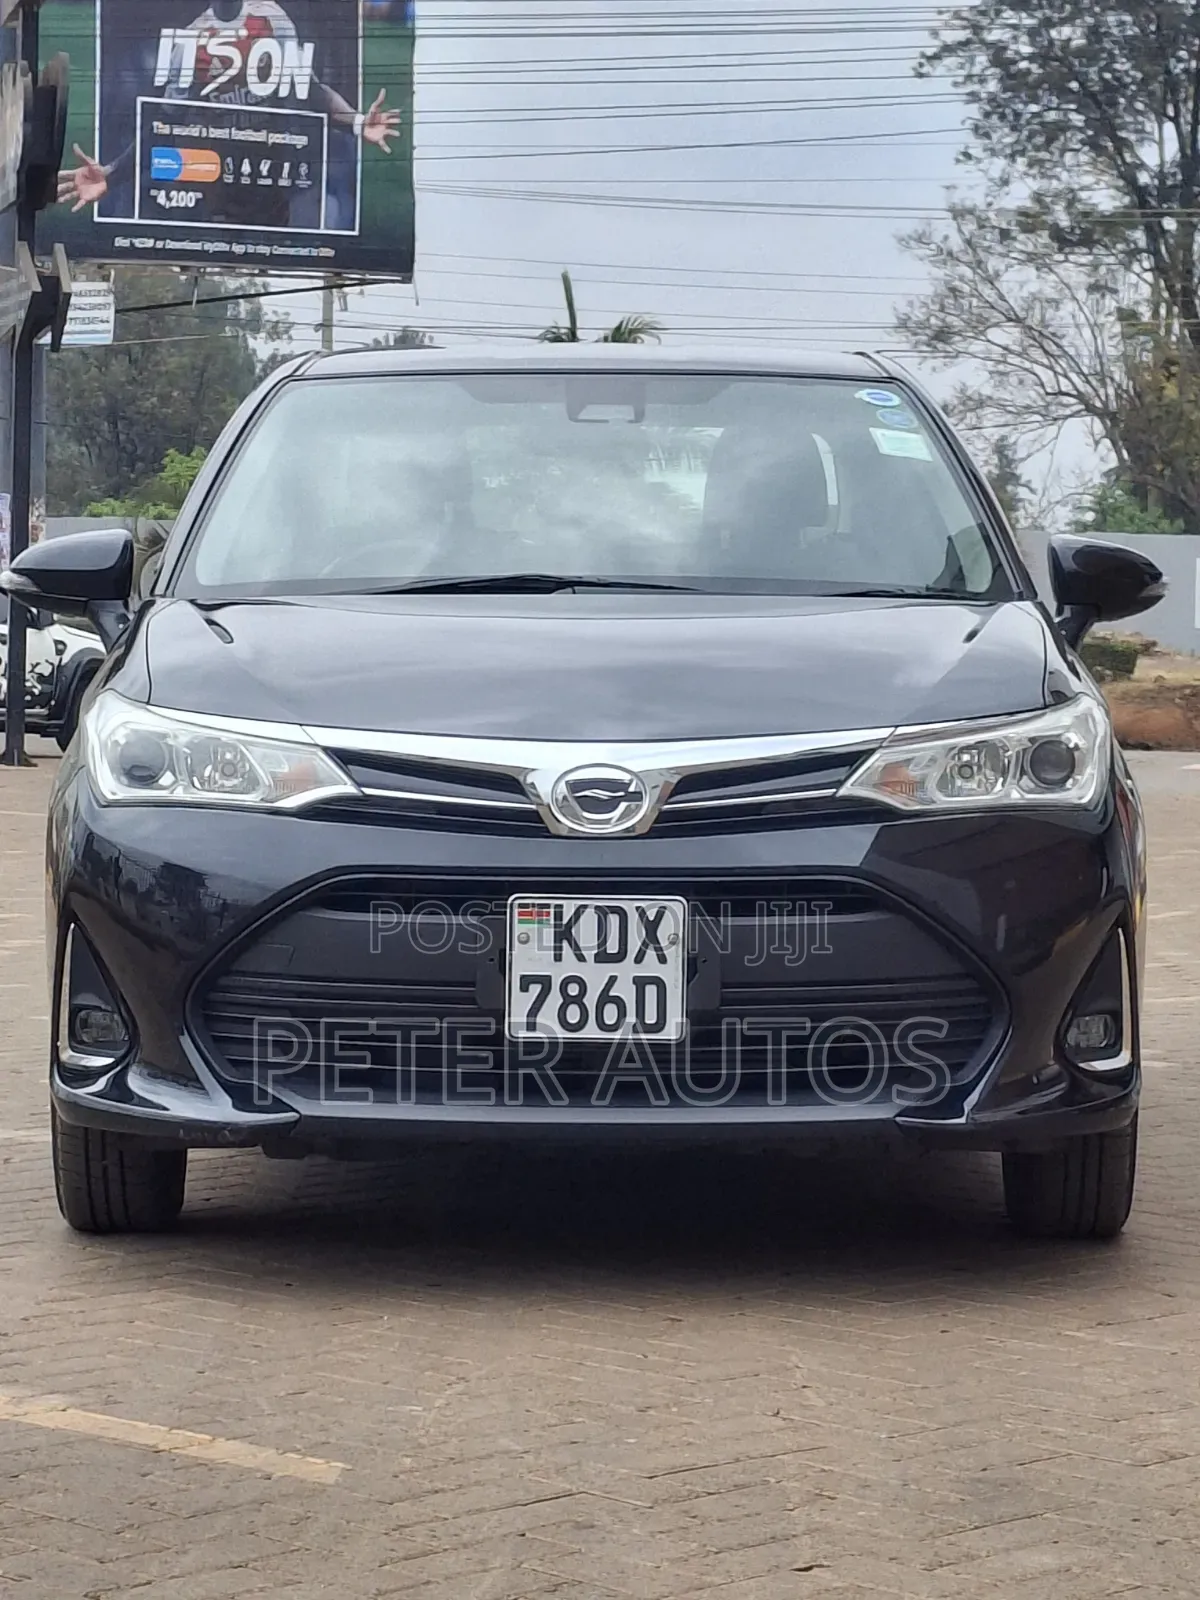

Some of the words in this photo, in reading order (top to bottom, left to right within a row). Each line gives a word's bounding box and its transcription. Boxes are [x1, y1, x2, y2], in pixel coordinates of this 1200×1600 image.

[246, 37, 315, 100] ON
[553, 904, 668, 965] KDX
[518, 974, 668, 1033] 786D
